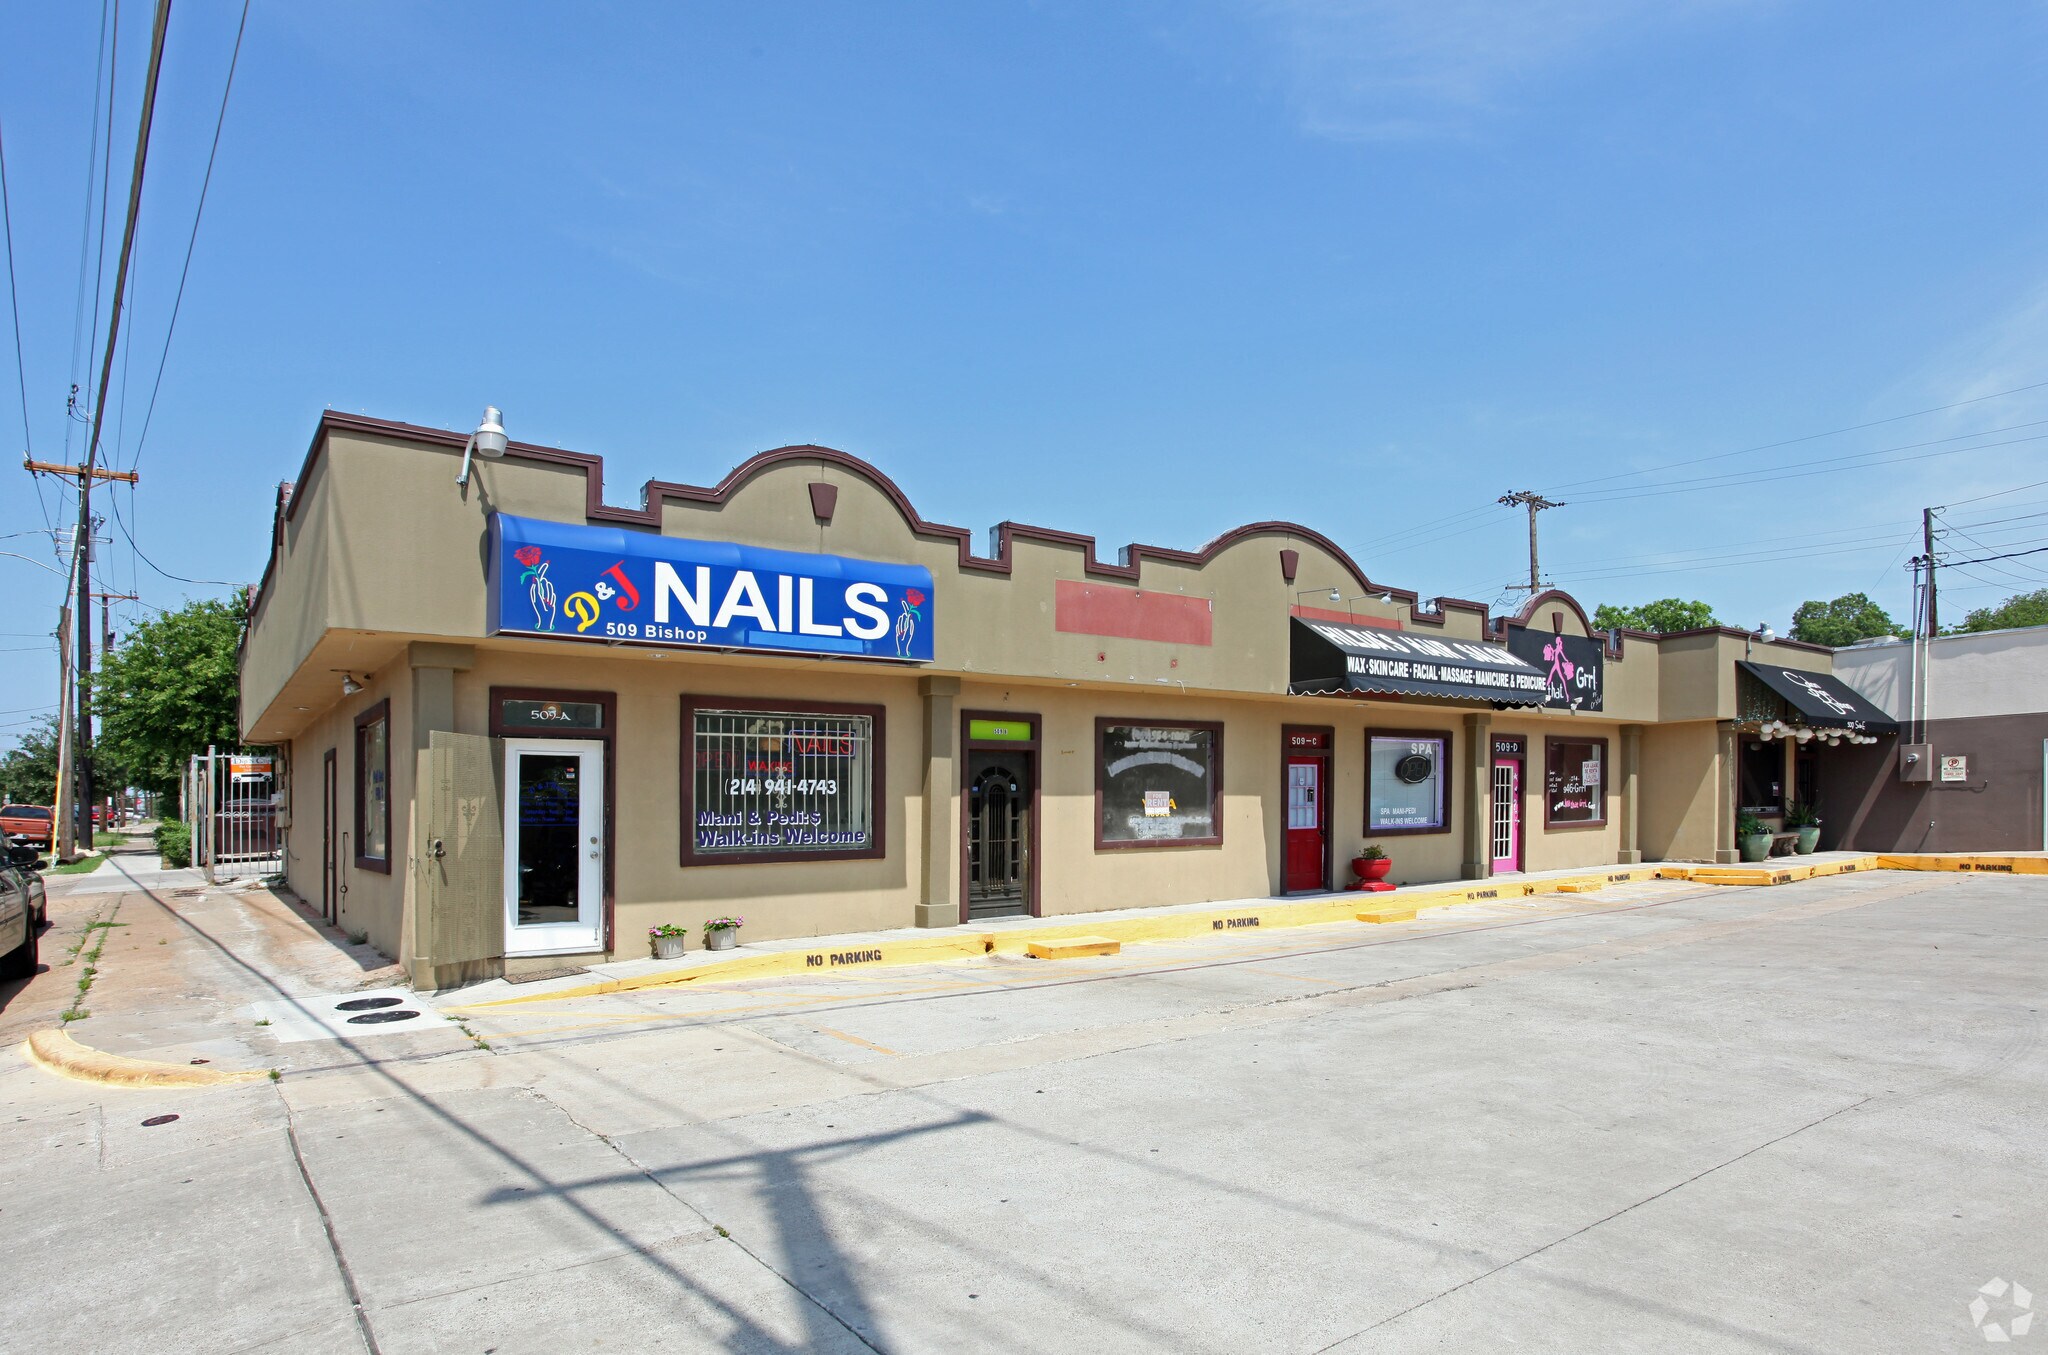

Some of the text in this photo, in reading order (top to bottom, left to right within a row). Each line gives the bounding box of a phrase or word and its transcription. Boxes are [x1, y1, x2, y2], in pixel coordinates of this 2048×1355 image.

[654, 562, 890, 639] NAILS
[606, 622, 707, 643] 509 Bishop
[1311, 624, 1528, 667] HILDA'S HAIR SALON
[1347, 656, 1547, 691] WAX SKIN CARE FACIAL MASSAGE MANICURE & PEDICURE
[531, 710, 571, 720] 509-A
[1291, 736, 1317, 745] 509-C
[1495, 742, 1518, 752] 509-D
[1411, 742, 1433, 755] SPA
[748, 759, 793, 773] WAXING
[764, 778, 838, 795] 941-4743
[1147, 798, 1168, 807] RENT
[1380, 807, 1417, 815] SPA MANI-PEDI
[699, 811, 742, 826] Mani
[748, 811, 762, 825] &
[1380, 816, 1428, 825] WALK-INS WELCOME
[700, 827, 866, 847] Walk-ins Welcome
[1975, 863, 2013, 871] PARKING
[1615, 873, 1631, 881] PARKING
[1467, 889, 1498, 900] NO PARKING
[1213, 917, 1259, 930] NO PARKING
[806, 950, 882, 967] NO PARKING
